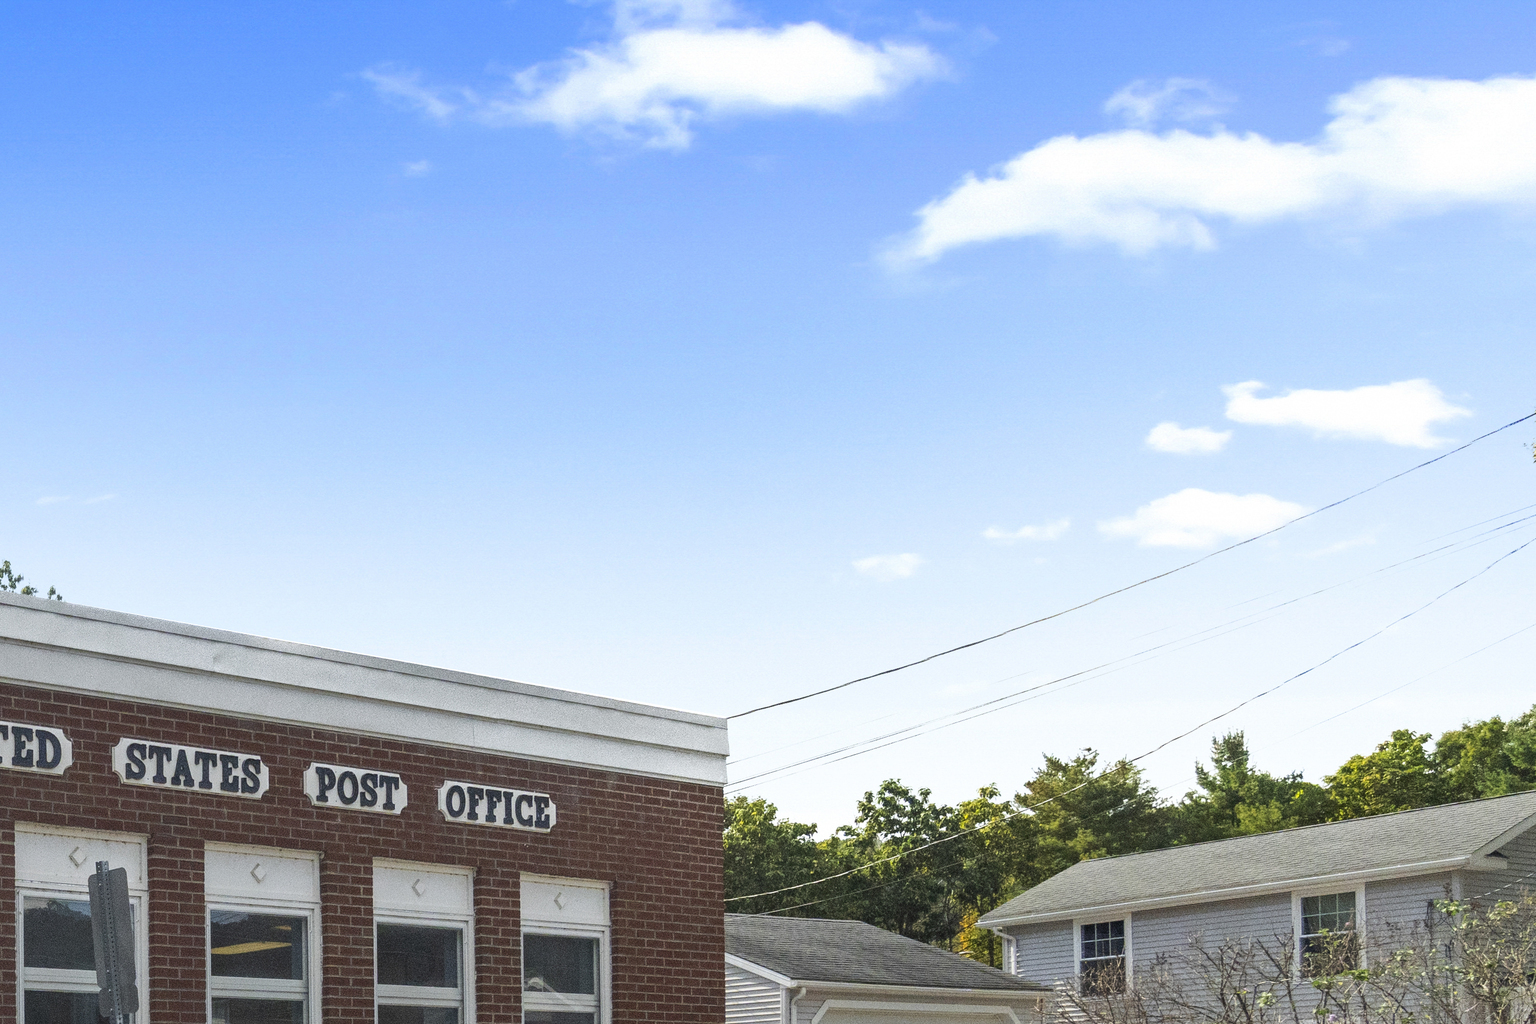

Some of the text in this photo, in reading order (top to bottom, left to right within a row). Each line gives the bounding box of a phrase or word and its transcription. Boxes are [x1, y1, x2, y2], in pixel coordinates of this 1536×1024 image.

[125, 743, 261, 794] STATES
[316, 767, 401, 811] POST
[445, 791, 551, 829] OFFICE
